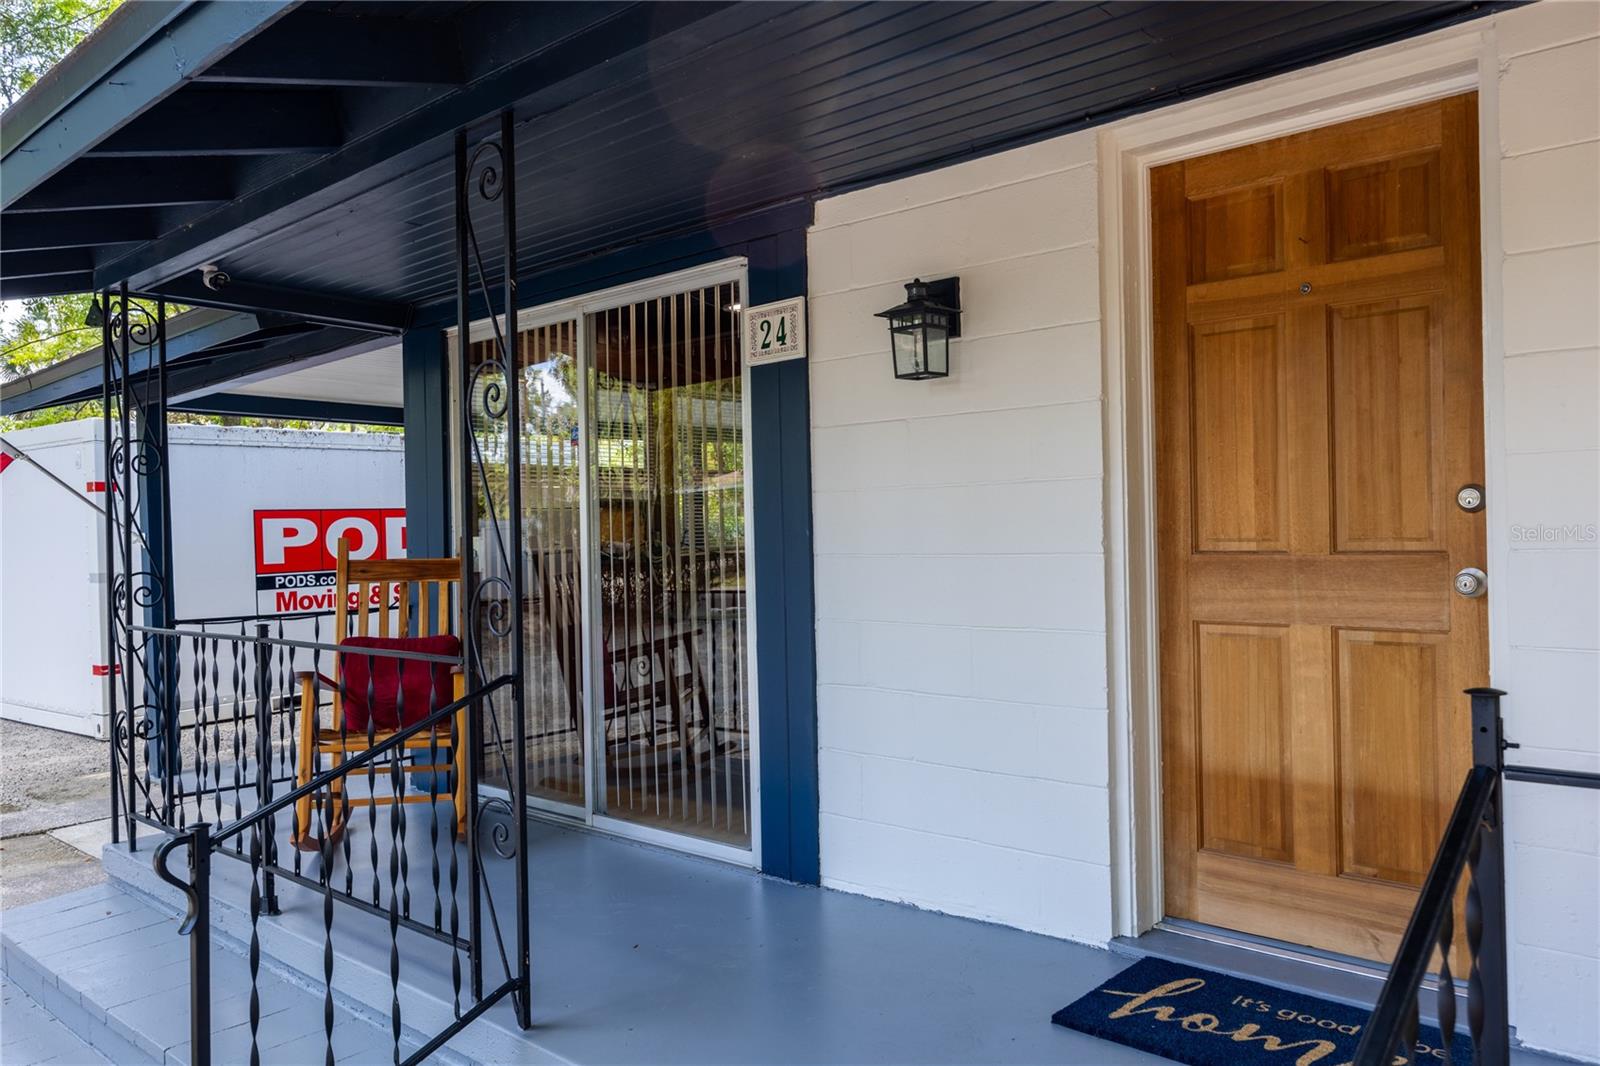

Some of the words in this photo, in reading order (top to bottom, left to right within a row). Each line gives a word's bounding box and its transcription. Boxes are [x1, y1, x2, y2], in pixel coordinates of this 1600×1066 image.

[760, 316, 787, 350] 24
[276, 588, 360, 612] Movig
[1102, 978, 1408, 1066] hom
[1231, 995, 1271, 1012] It's
[1275, 1008, 1361, 1036] good
